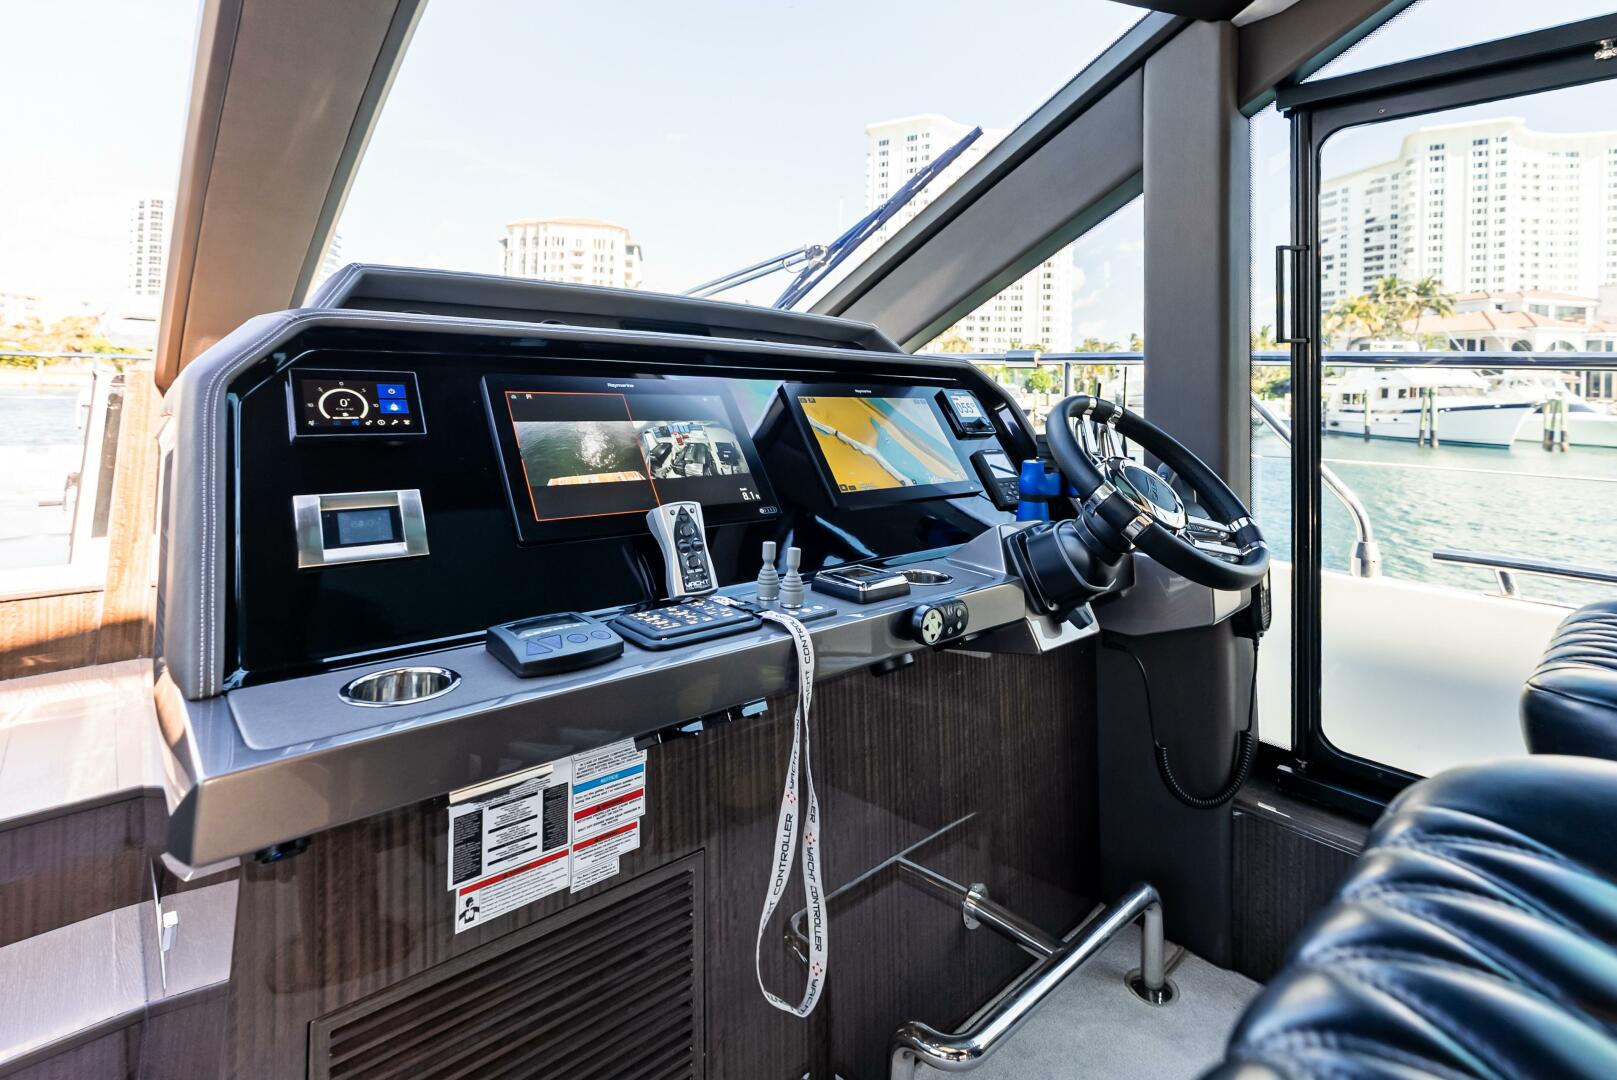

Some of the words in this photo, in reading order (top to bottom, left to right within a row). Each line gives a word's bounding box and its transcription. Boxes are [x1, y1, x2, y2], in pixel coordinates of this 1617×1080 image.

[773, 813, 794, 896] CONTROLLER
[806, 846, 816, 882] YACHT
[810, 885, 822, 952] CONTROLLER
